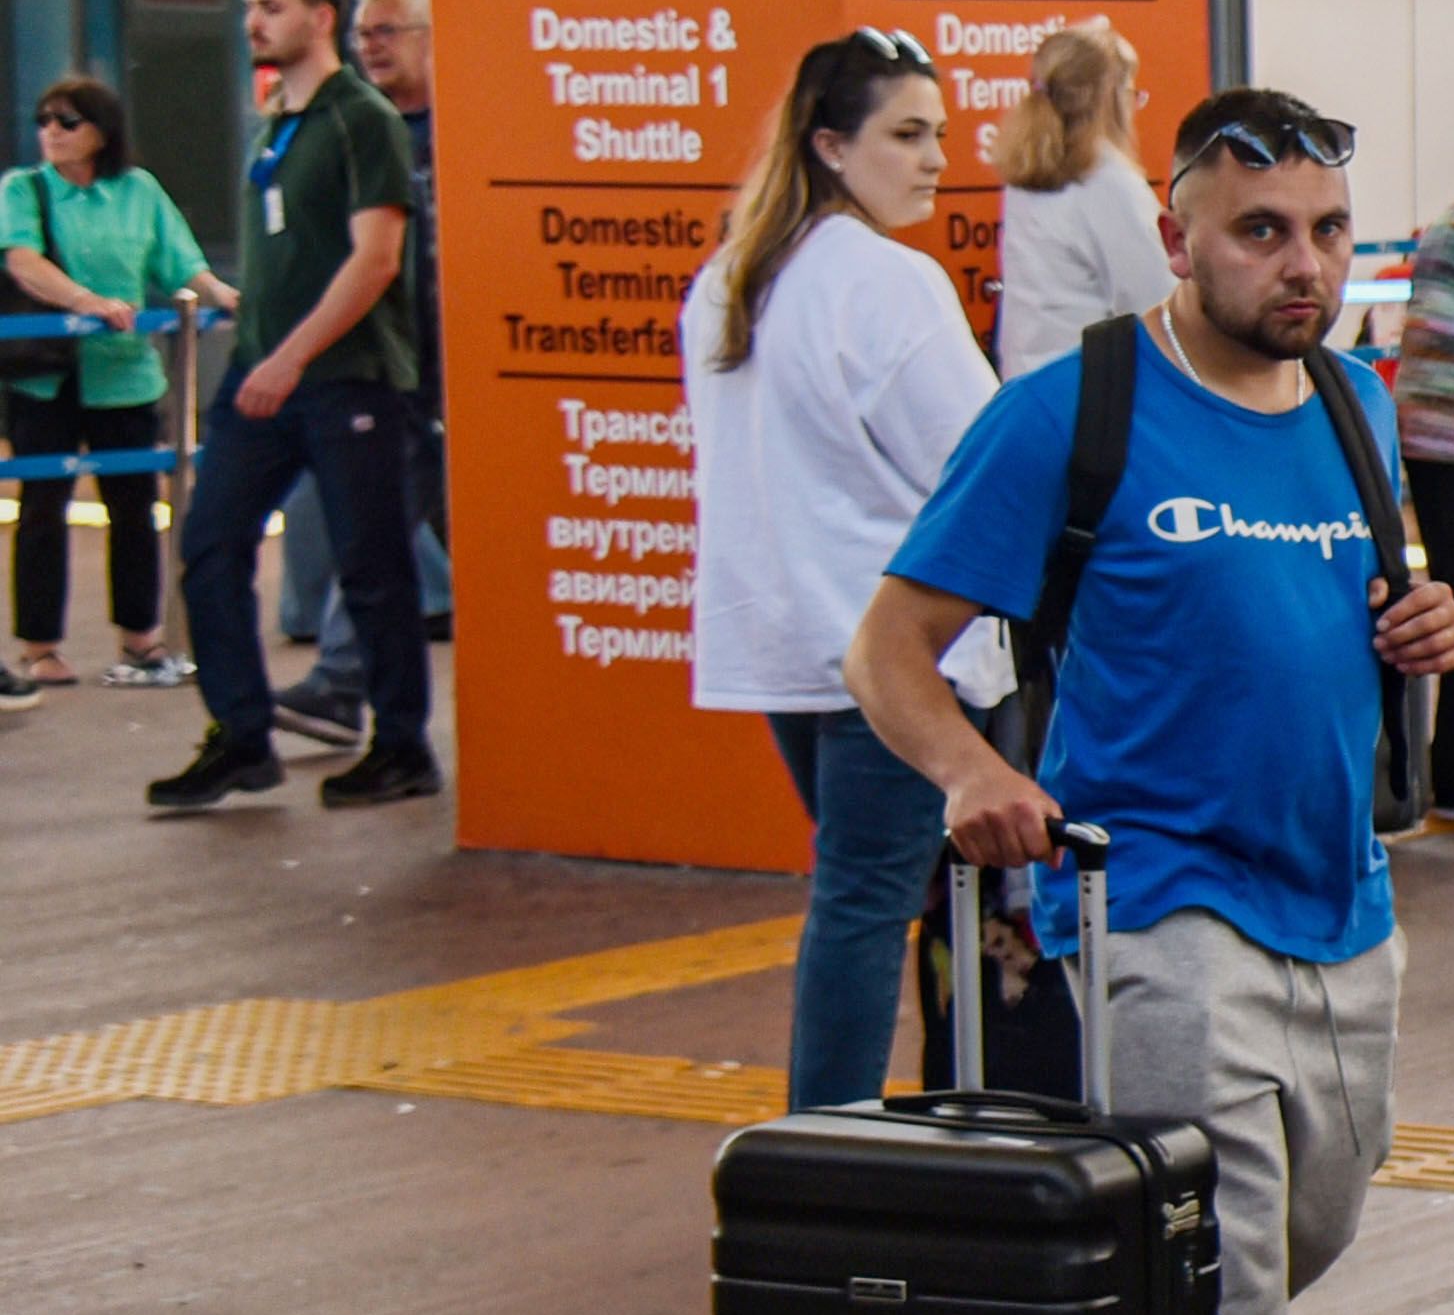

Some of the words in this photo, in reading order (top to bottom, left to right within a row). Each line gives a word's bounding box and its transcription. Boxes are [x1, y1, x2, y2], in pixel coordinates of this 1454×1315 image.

[531, 7, 700, 51] Domestic
[707, 7, 737, 51] &
[937, 13, 1066, 55] Domes
[546, 63, 700, 107] Terminal
[709, 65, 729, 107] 1
[953, 69, 1031, 110] Term
[574, 119, 703, 162] Shuttle
[541, 207, 706, 247] Domestic
[558, 262, 694, 301] Termina
[504, 316, 680, 357] Transferfa
[558, 398, 696, 455] Трансф
[564, 454, 698, 505] Термин
[548, 516, 697, 561] внутрен
[1148, 497, 1374, 560] Champi
[549, 570, 696, 614] авиарей
[557, 615, 696, 667] Термин
